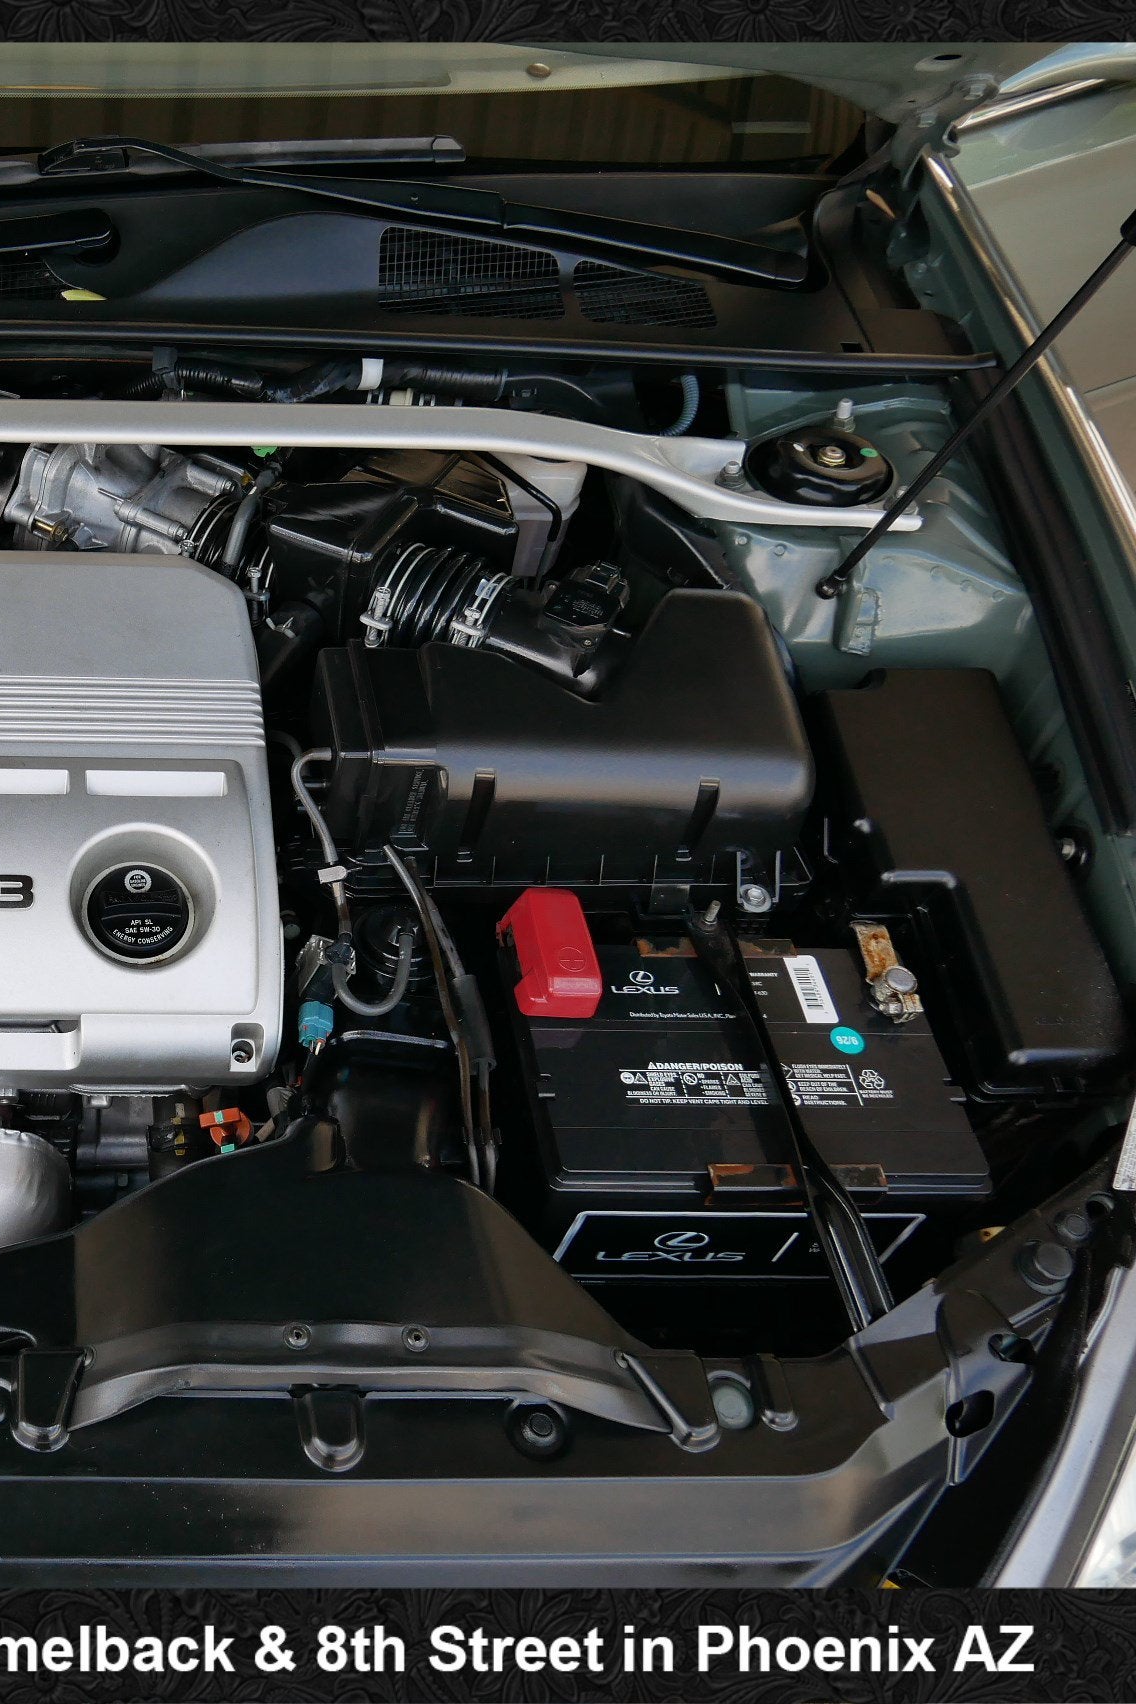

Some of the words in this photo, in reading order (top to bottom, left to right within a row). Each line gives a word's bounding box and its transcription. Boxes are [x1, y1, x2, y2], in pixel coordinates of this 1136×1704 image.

[112, 928, 136, 944] ENERGY
[137, 925, 174, 944] CONSERVING
[611, 985, 680, 995] LEXUS
[655, 1062, 744, 1070] DANGER/POISON
[596, 1251, 746, 1262] LEXUS
